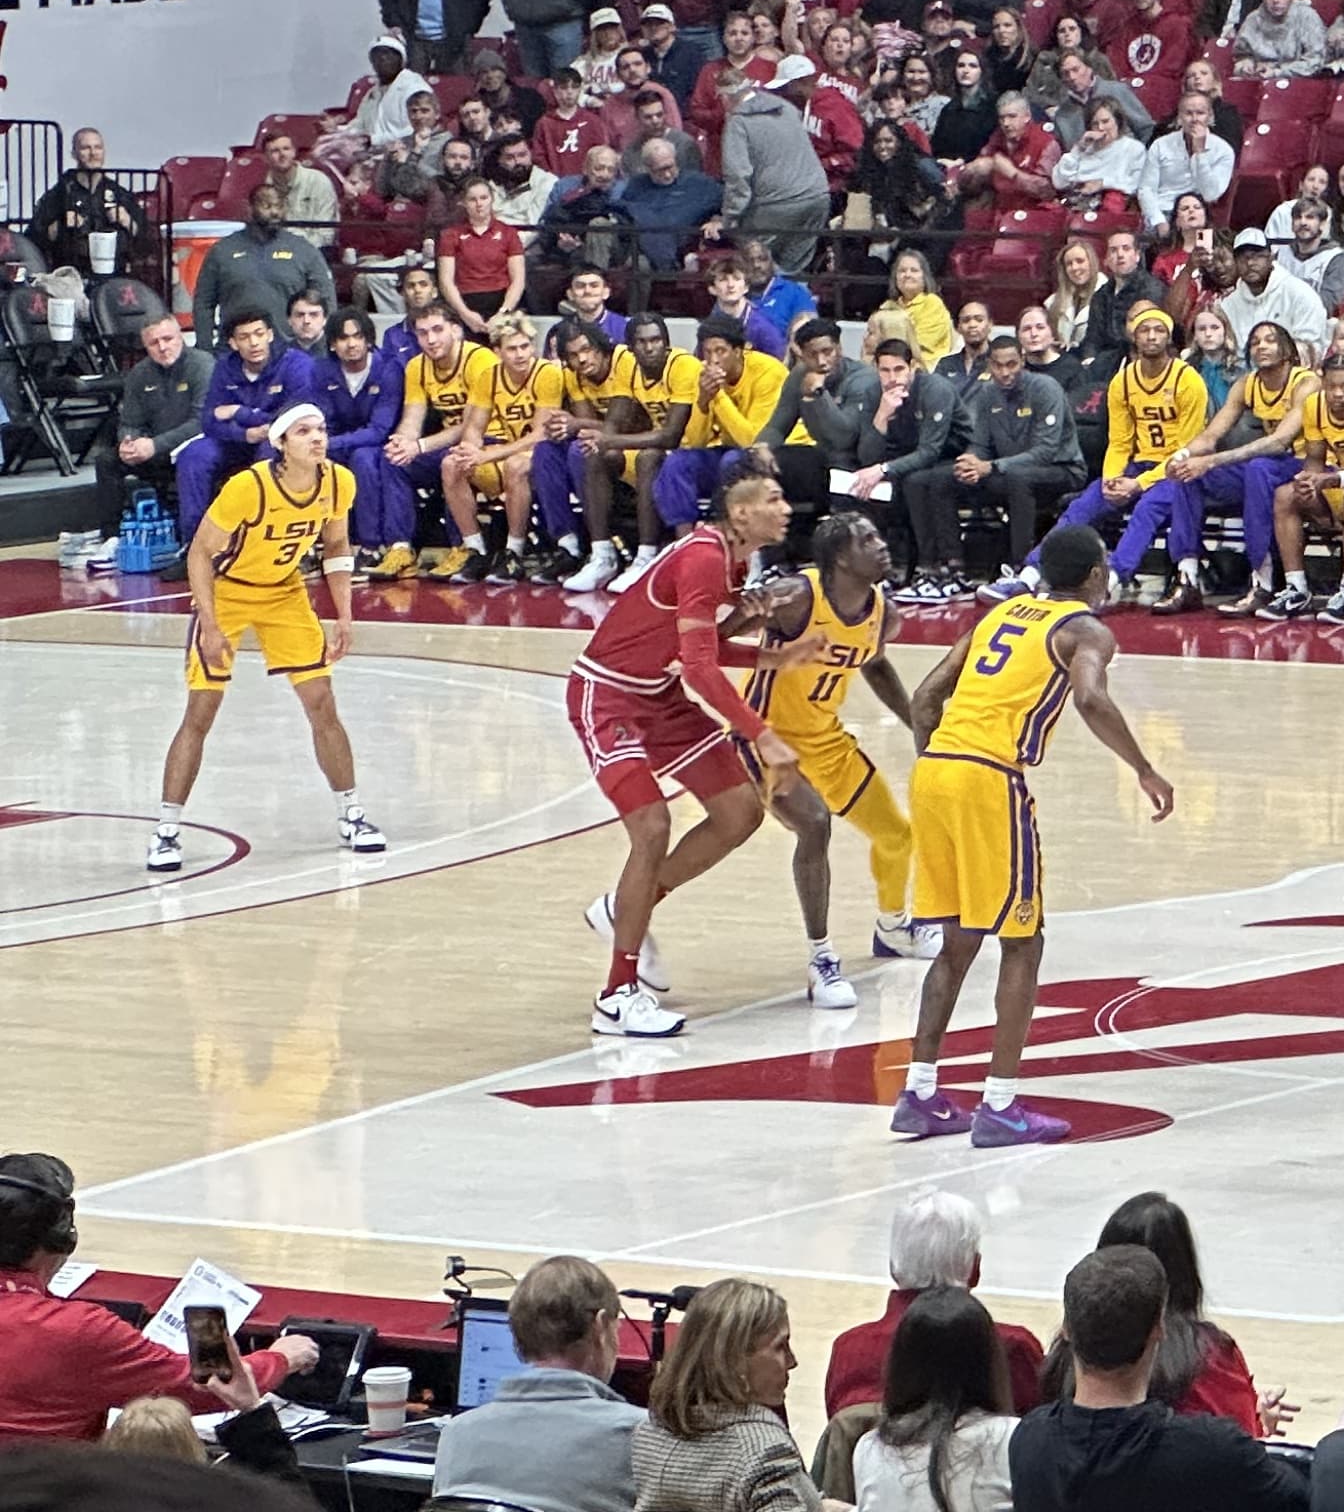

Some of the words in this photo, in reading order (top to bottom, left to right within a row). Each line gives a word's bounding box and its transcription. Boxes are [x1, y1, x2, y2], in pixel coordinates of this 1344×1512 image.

[1134, 406, 1178, 422] LSU
[825, 643, 869, 668] SU
[975, 622, 1028, 676] 5
[807, 671, 844, 702] 11
